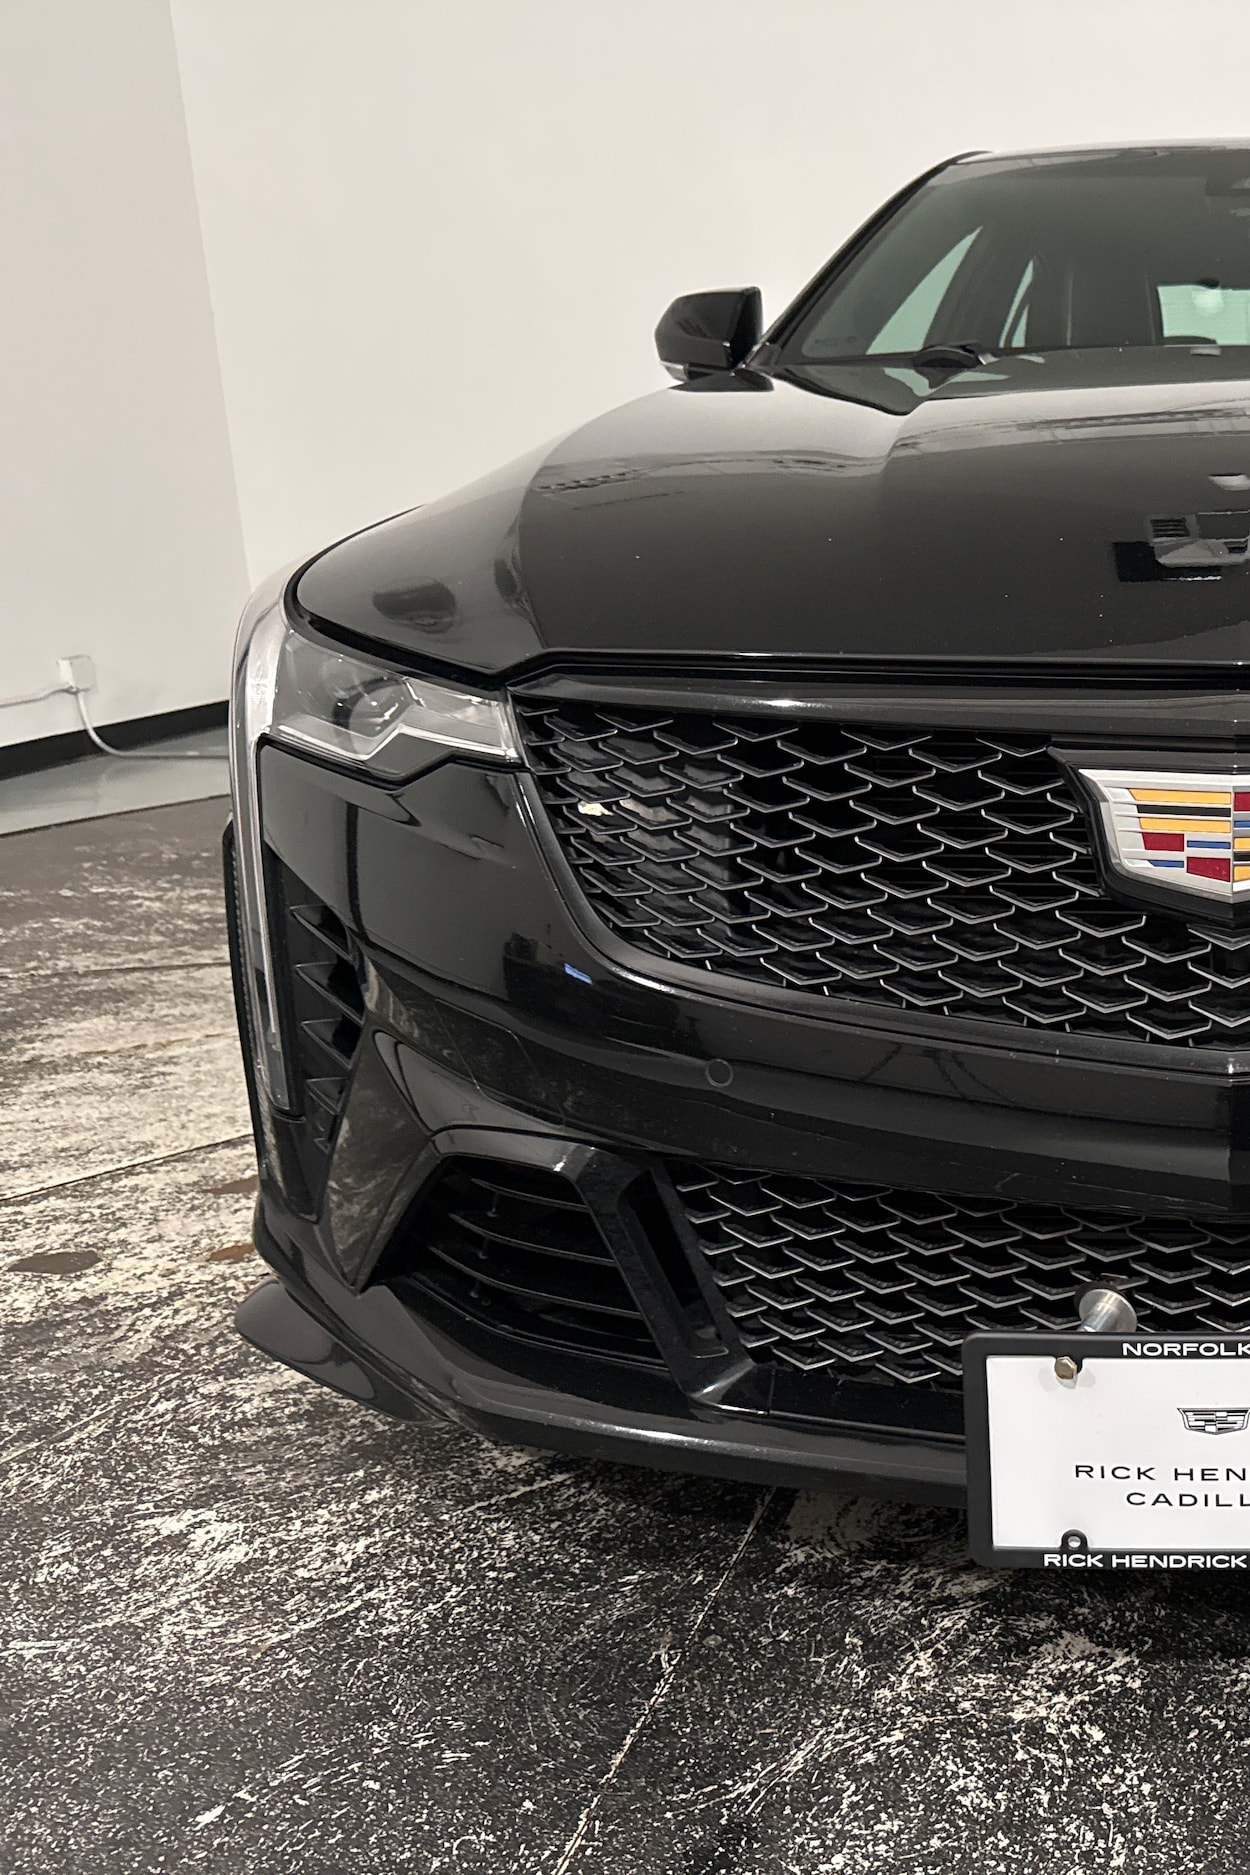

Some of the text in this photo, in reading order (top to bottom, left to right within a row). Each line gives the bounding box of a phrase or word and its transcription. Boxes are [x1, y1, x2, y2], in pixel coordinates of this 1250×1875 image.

[1076, 1465, 1155, 1481] RICK
[1043, 1553, 1104, 1568] RICK
[1111, 1555, 1248, 1569] HENDRICK
